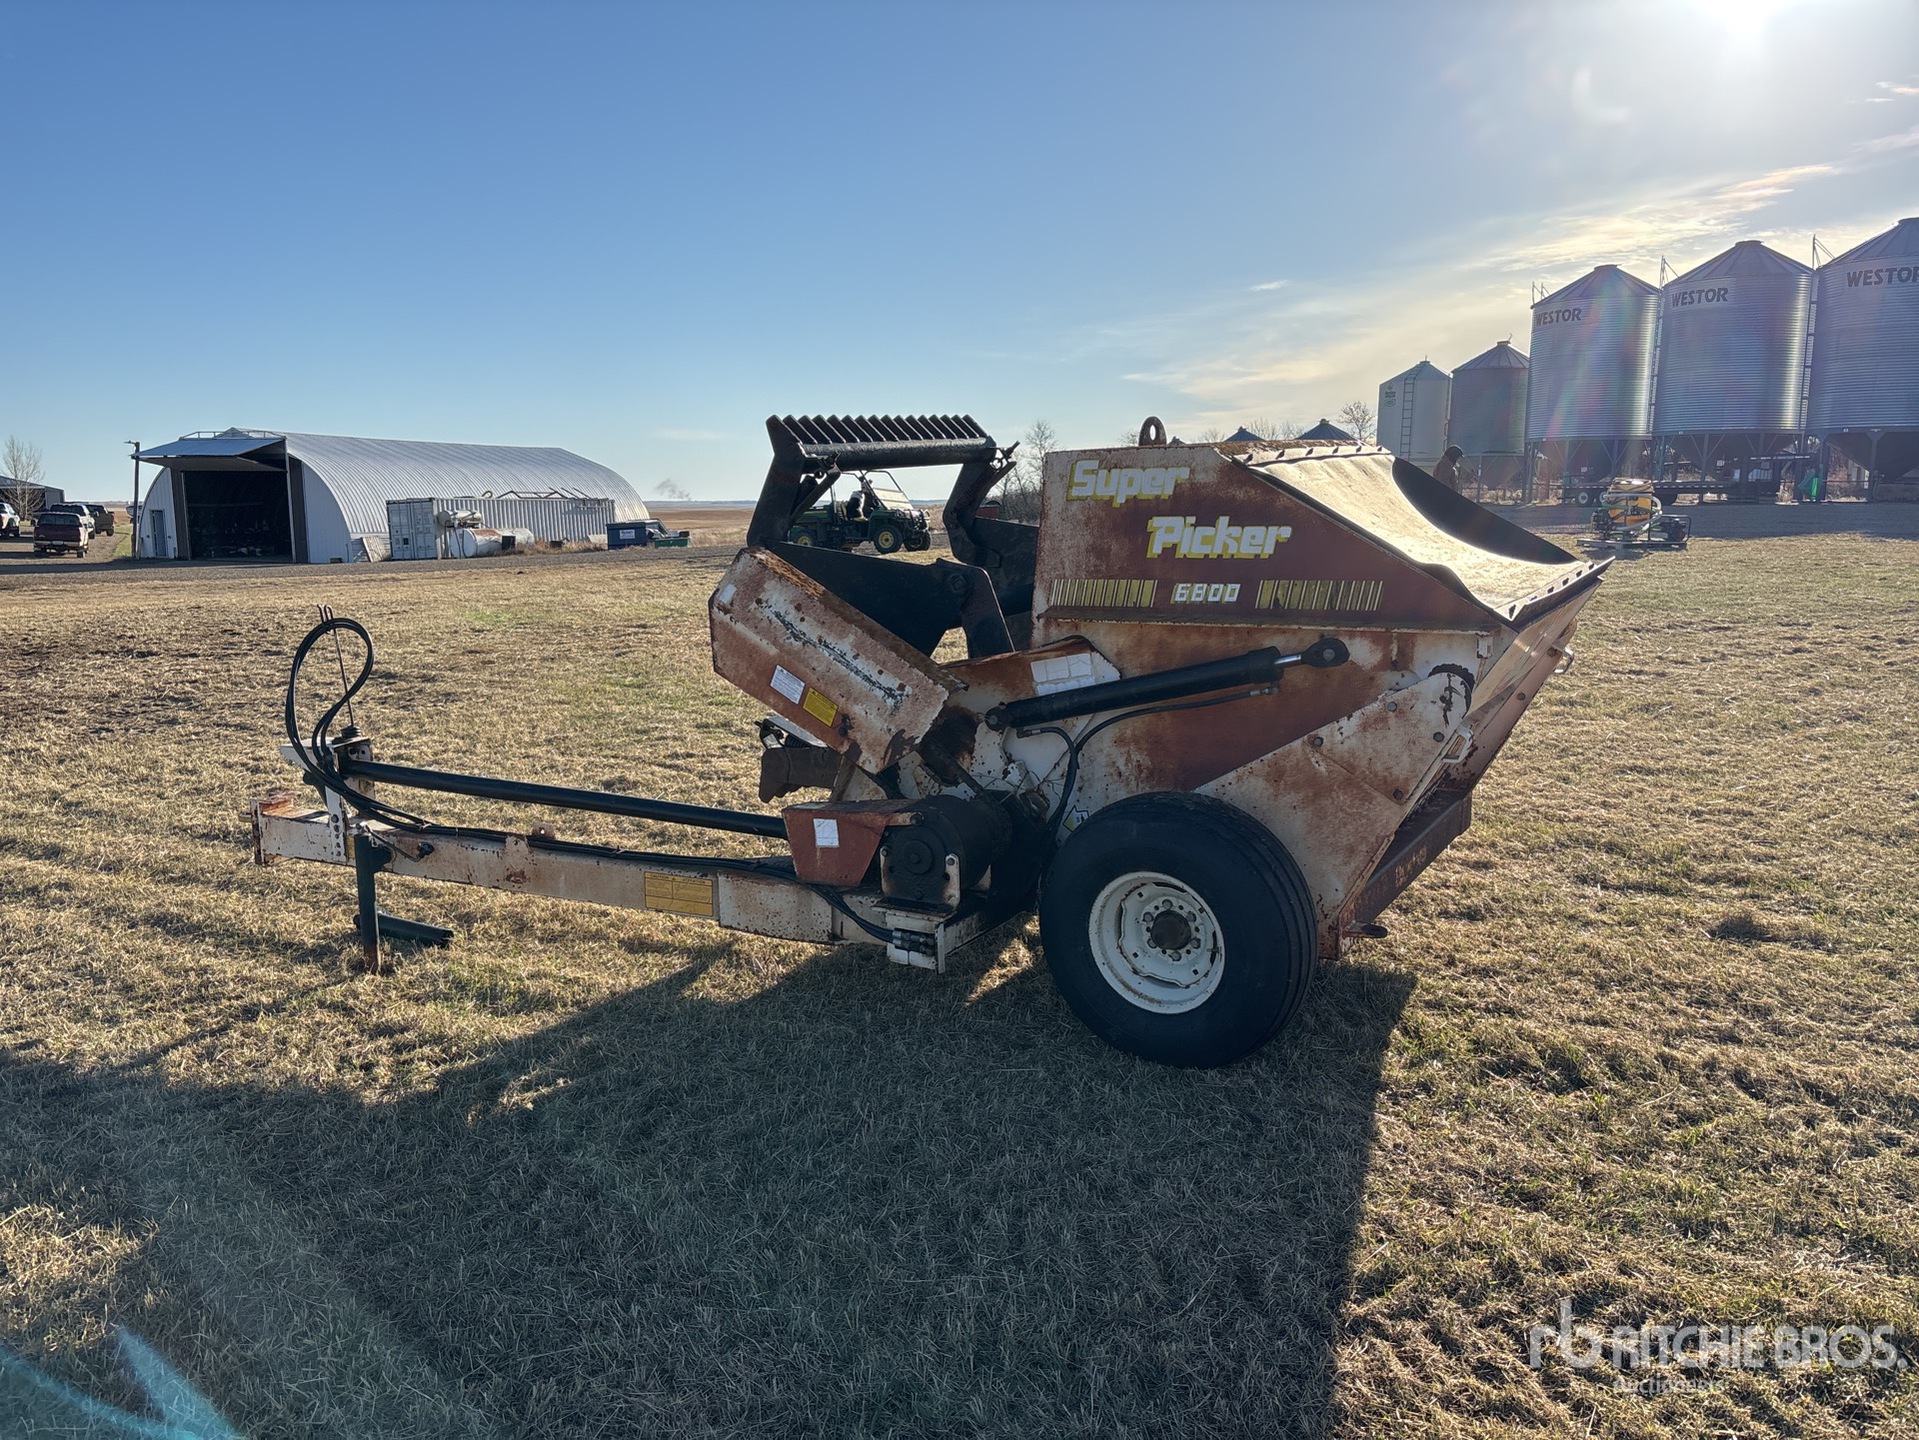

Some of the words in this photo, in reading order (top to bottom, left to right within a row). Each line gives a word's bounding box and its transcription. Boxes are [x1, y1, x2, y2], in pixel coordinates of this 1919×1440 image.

[1671, 287, 1729, 307] WESTOR
[1536, 308, 1582, 327] WESTOR
[1066, 459, 1190, 507] Super
[1146, 516, 1292, 559] Picker
[1170, 583, 1241, 604] 6800
